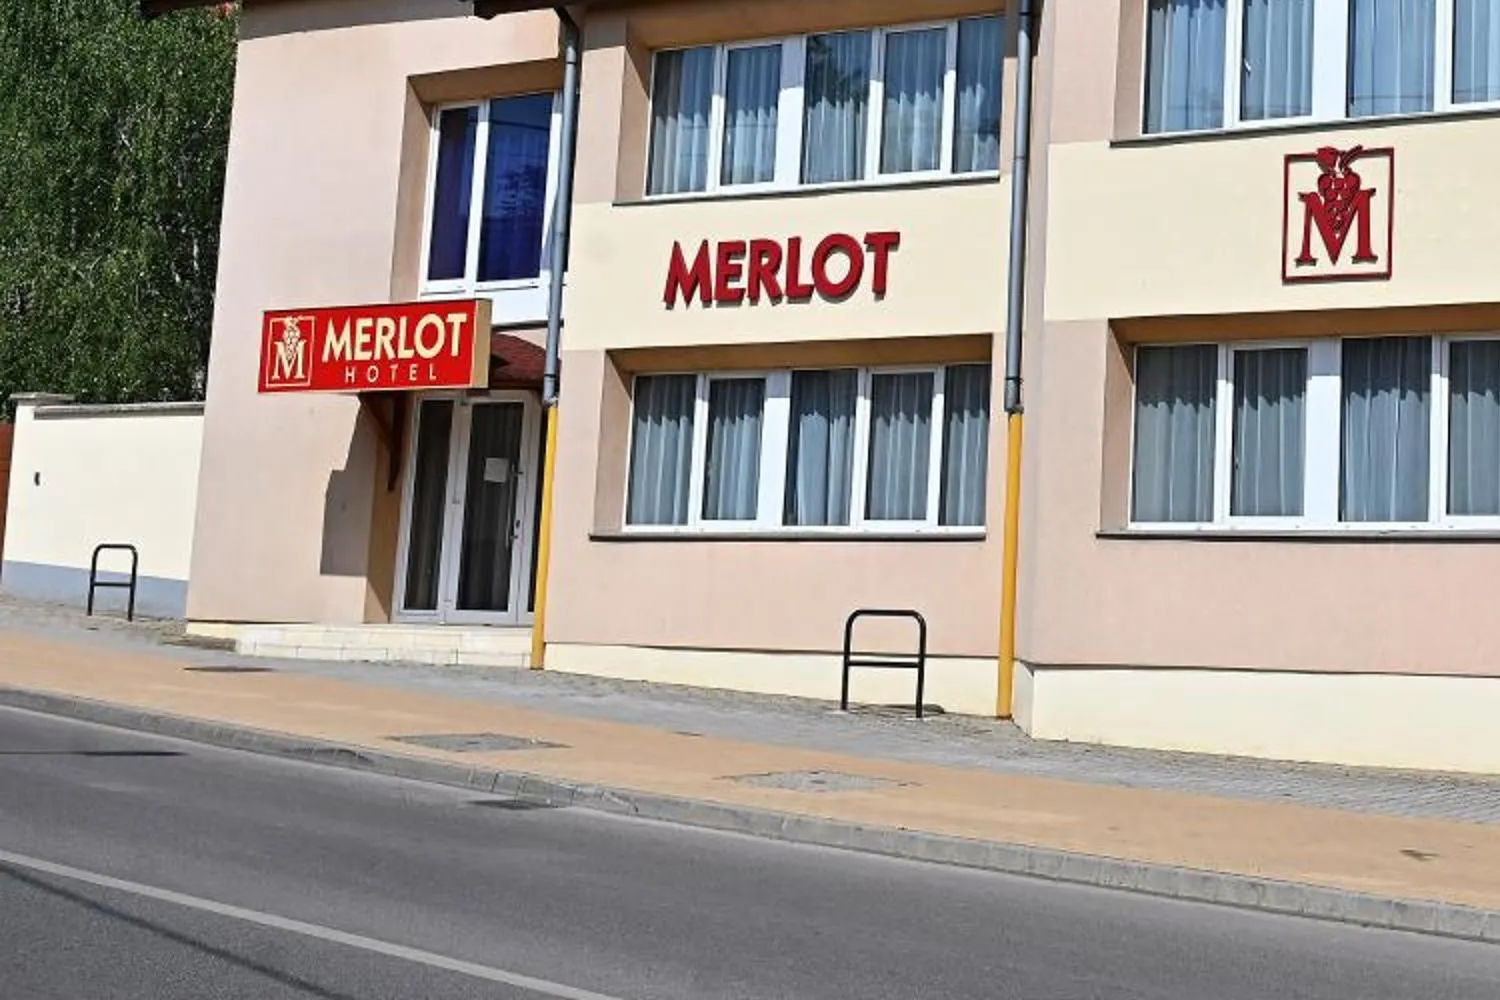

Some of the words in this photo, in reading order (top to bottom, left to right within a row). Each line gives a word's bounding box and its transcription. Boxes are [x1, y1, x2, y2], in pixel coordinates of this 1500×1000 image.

[1294, 187, 1379, 267] M
[663, 231, 901, 309] MERLOT
[321, 313, 467, 363] MERLOT
[345, 363, 437, 383] HOTEL
